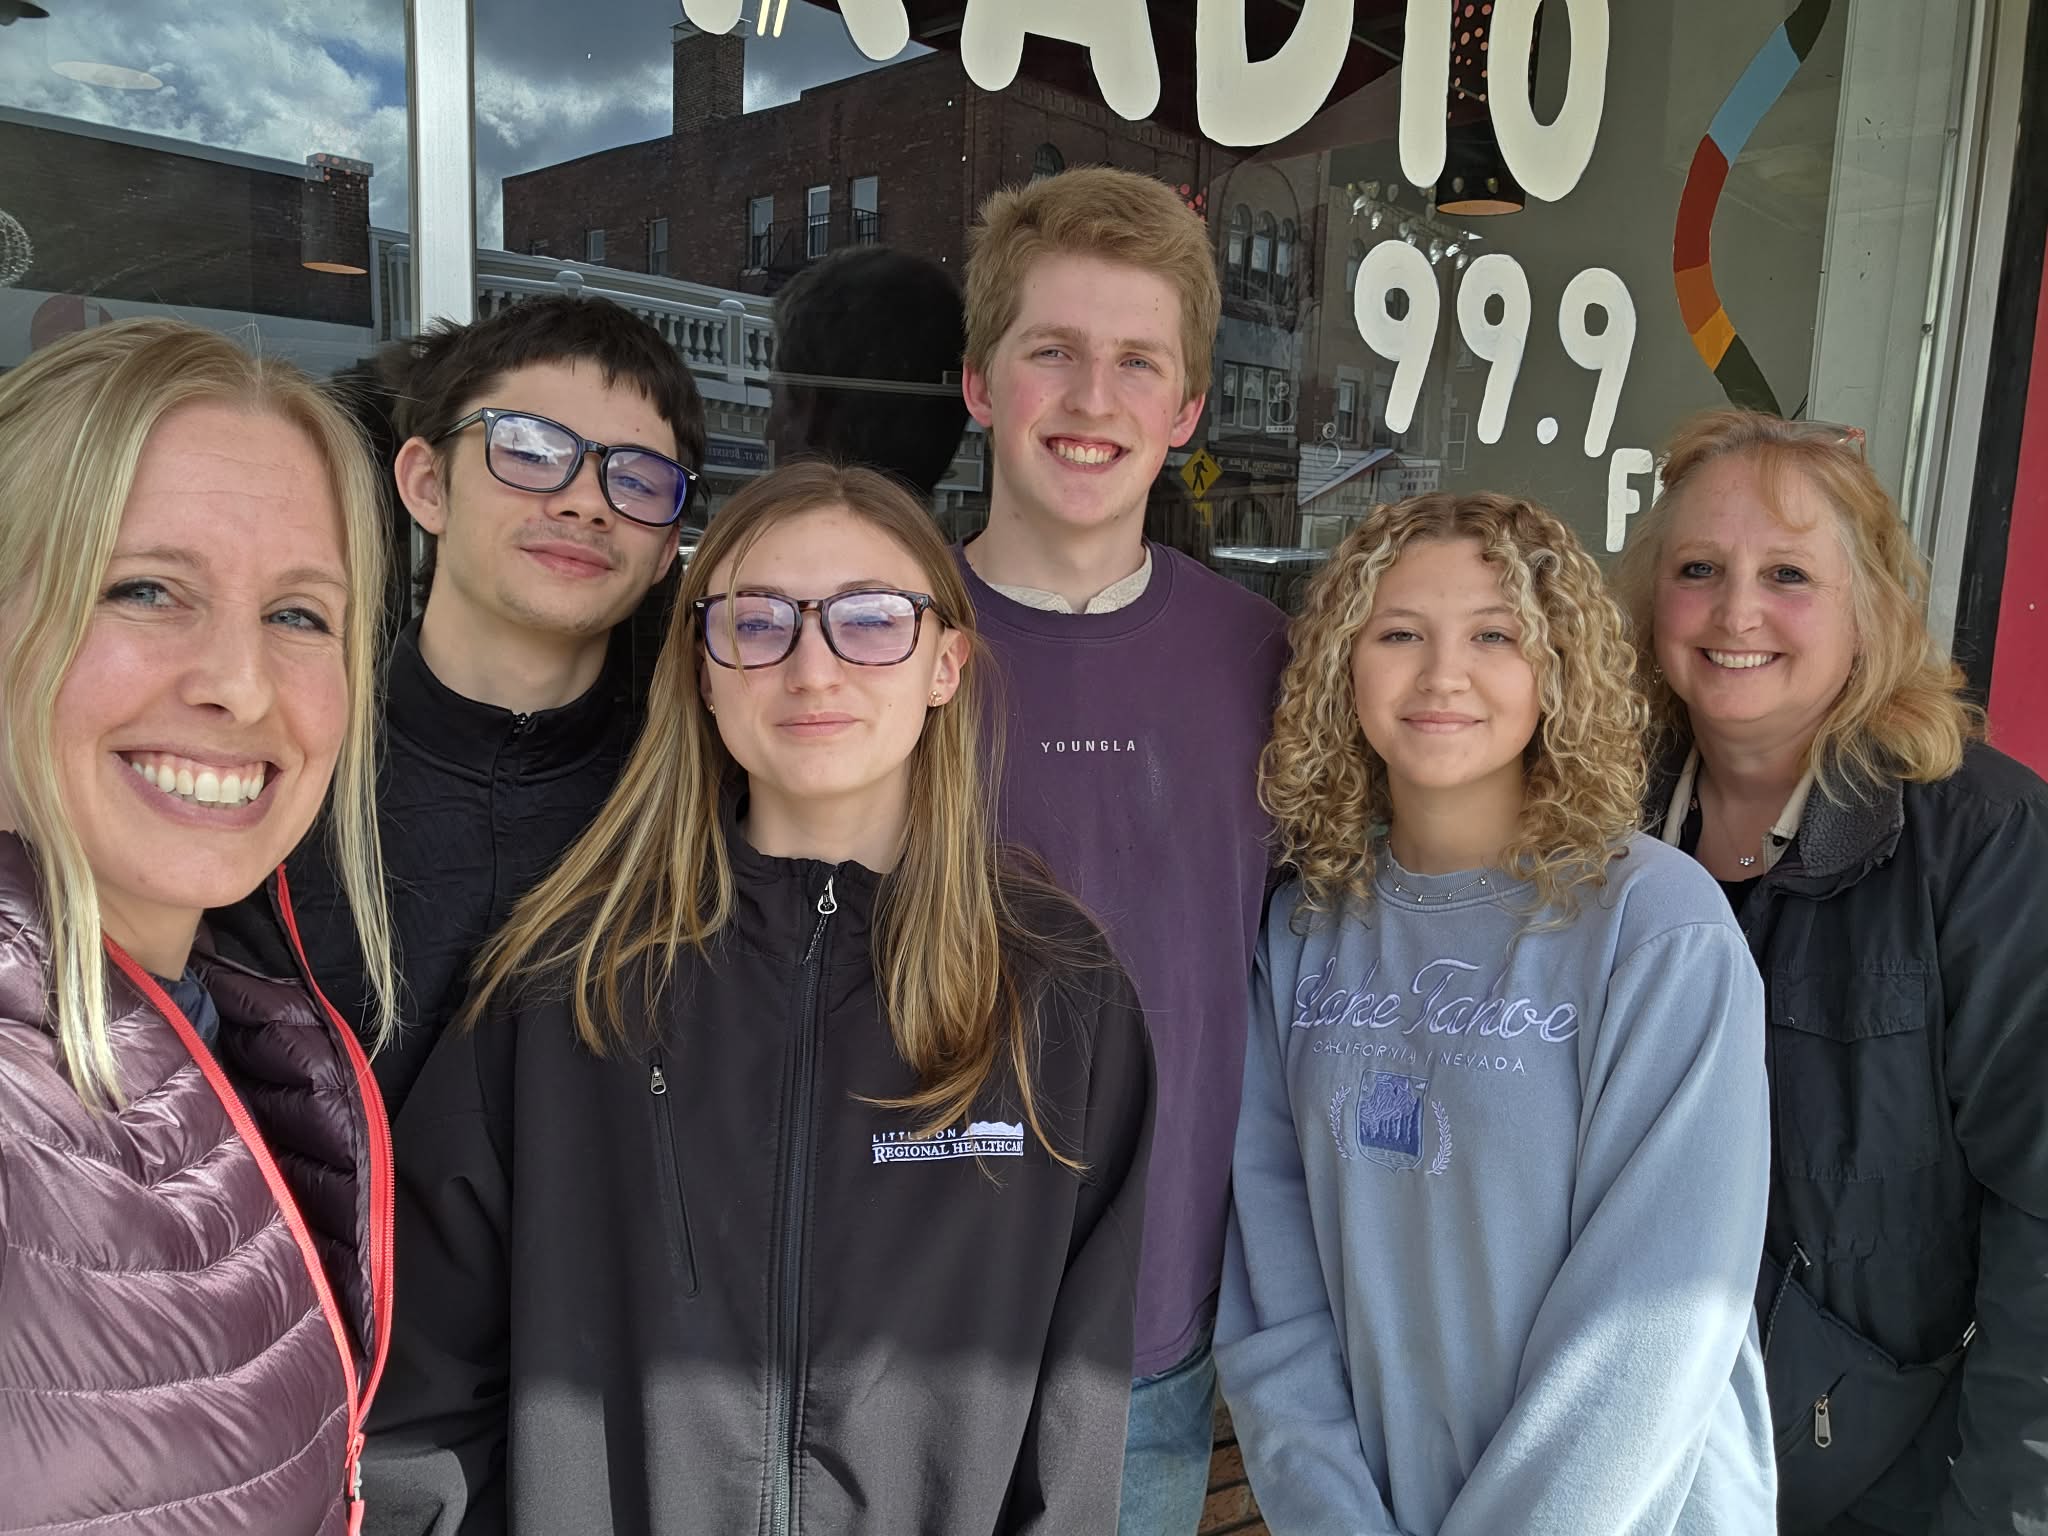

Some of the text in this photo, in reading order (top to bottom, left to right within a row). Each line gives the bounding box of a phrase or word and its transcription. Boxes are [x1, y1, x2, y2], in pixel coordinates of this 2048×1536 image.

[1354, 240, 1637, 458] 99.9
[1041, 740, 1135, 753] YOUNGLA
[1291, 957, 1580, 1042] Lake Tahoe
[1312, 1040, 1418, 1064] CALIFORNIA
[1440, 1053, 1527, 1074] NEVADA
[872, 1144, 950, 1164] REGIONAL
